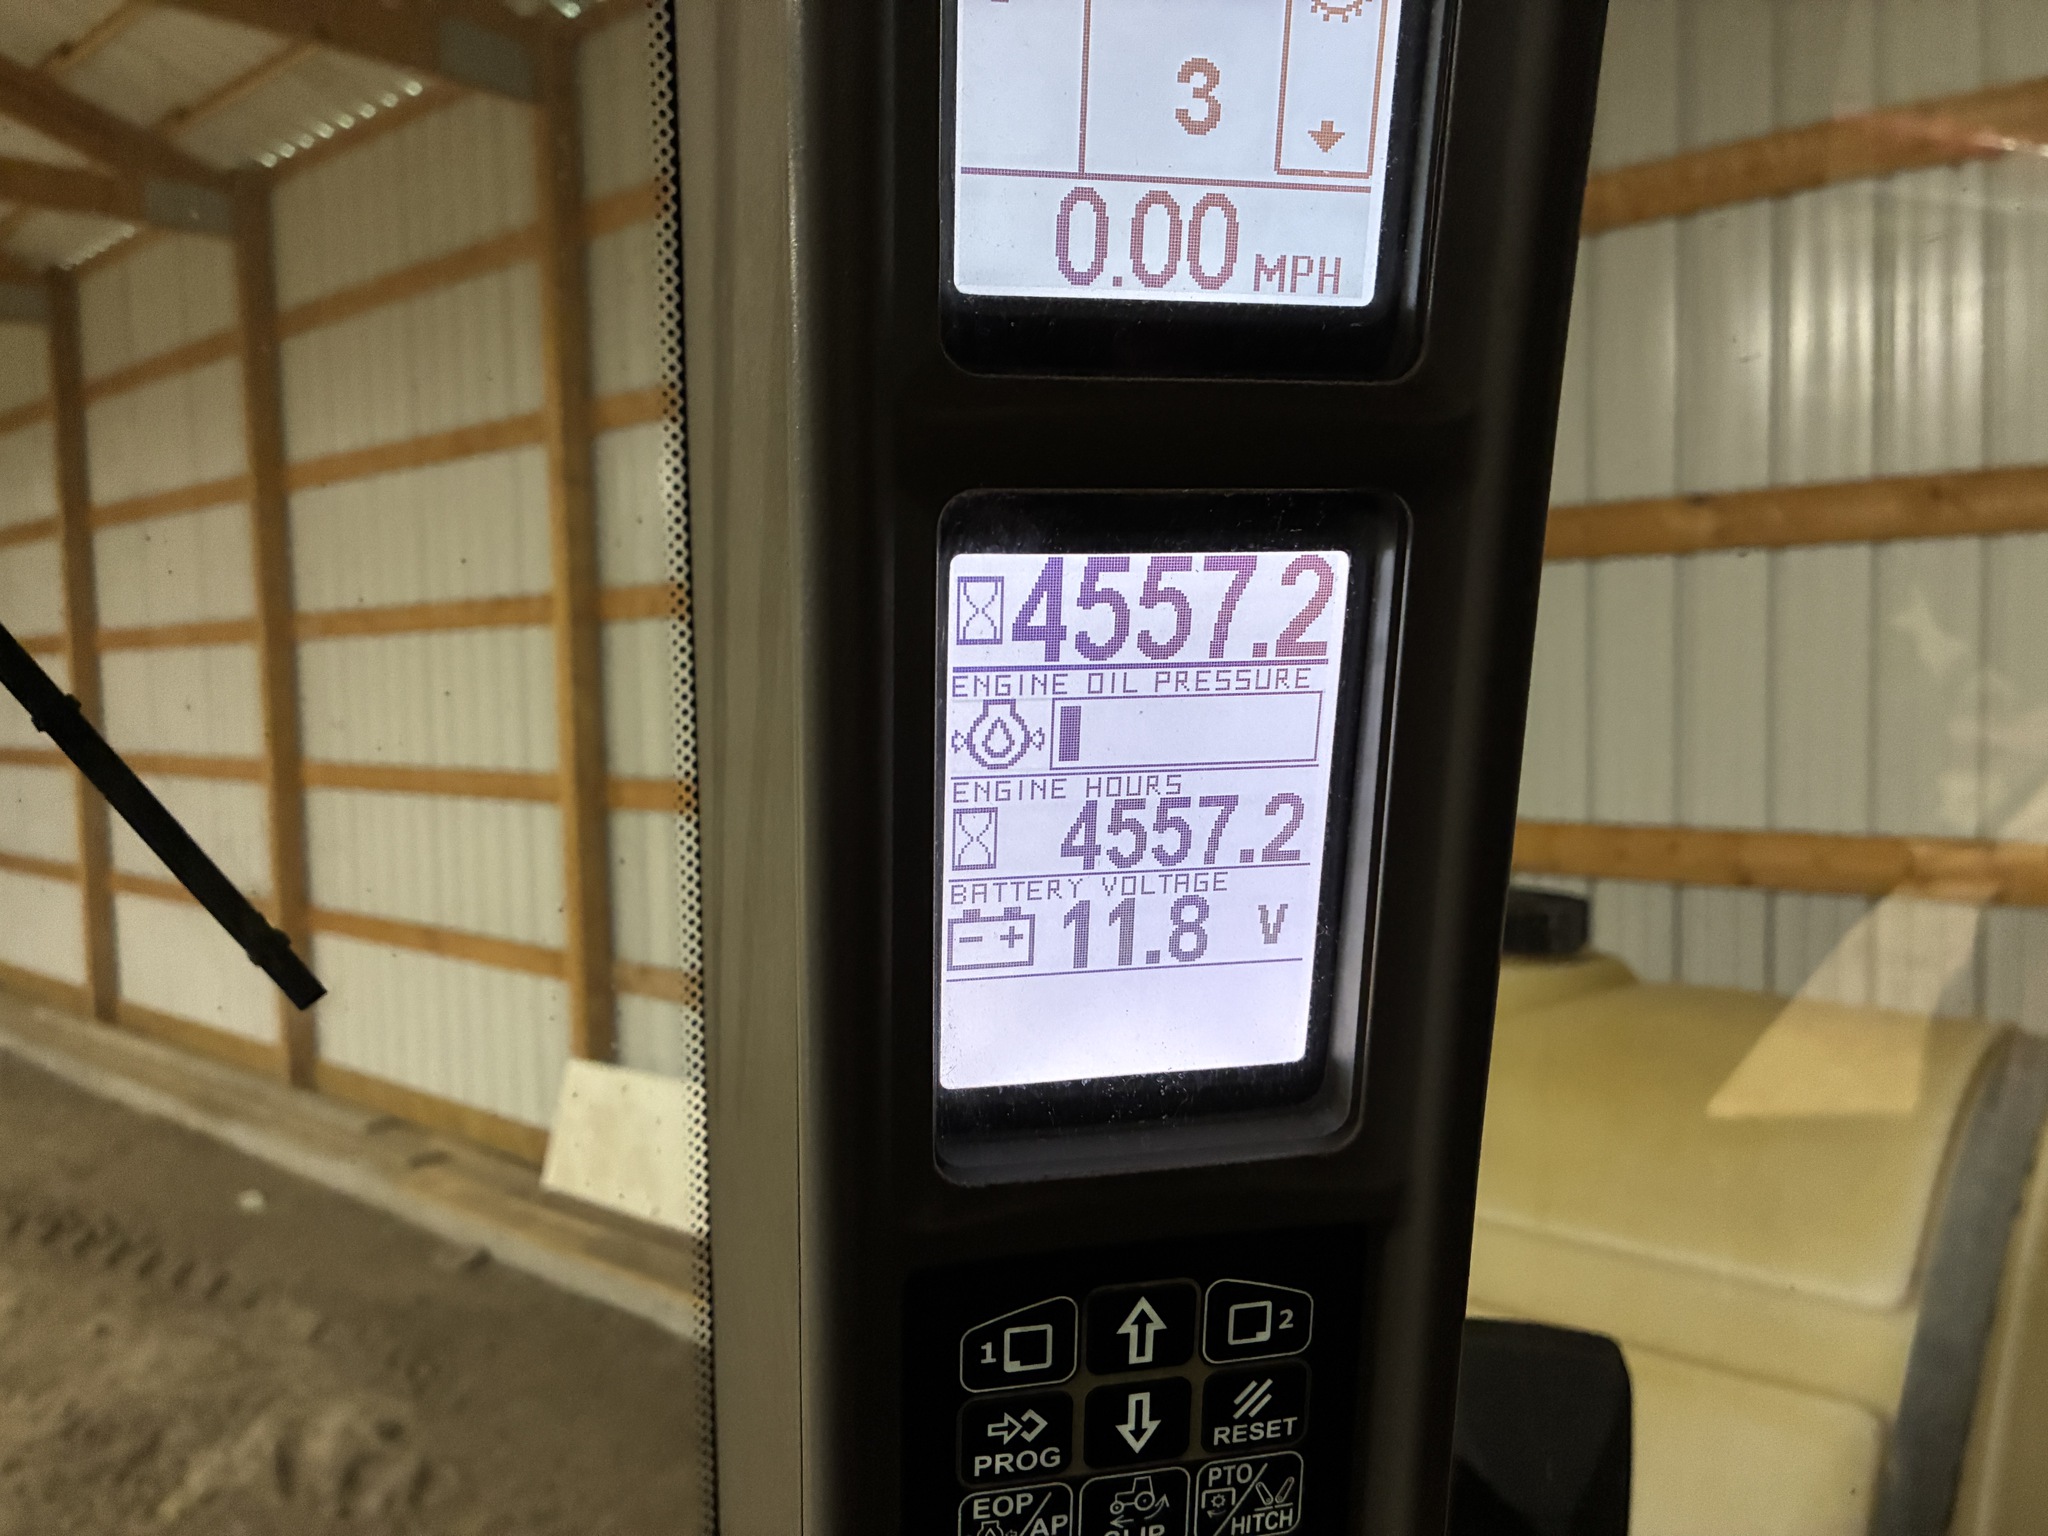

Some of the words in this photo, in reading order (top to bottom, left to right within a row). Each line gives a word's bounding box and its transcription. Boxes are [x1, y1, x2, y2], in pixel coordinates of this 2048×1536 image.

[1175, 57, 1221, 135] 3
[1056, 187, 1239, 290] 0.00
[1253, 254, 1341, 294] MPH
[1012, 554, 1334, 662] 4557.2
[952, 673, 1067, 697] ENGINE
[1088, 671, 1137, 693] OIL
[1154, 668, 1311, 692] PRESSURE
[953, 778, 1067, 803] ENGINE
[1086, 774, 1182, 797] HOURS
[1060, 792, 1305, 870] 4557.2
[951, 878, 1083, 905] BATTERY
[1102, 871, 1228, 896] VOLTAGE
[1063, 894, 1209, 969] 11.8
[1258, 903, 1288, 944] V
[1278, 1308, 1294, 1330] 2
[980, 1342, 997, 1364] 1
[1213, 1417, 1298, 1446] RESET
[973, 1447, 1061, 1477] PROG
[1208, 1463, 1253, 1487] PTO
[972, 1493, 1034, 1520] EOP
[1030, 1514, 1068, 1536] AP
[1231, 1508, 1294, 1536] HITCH
